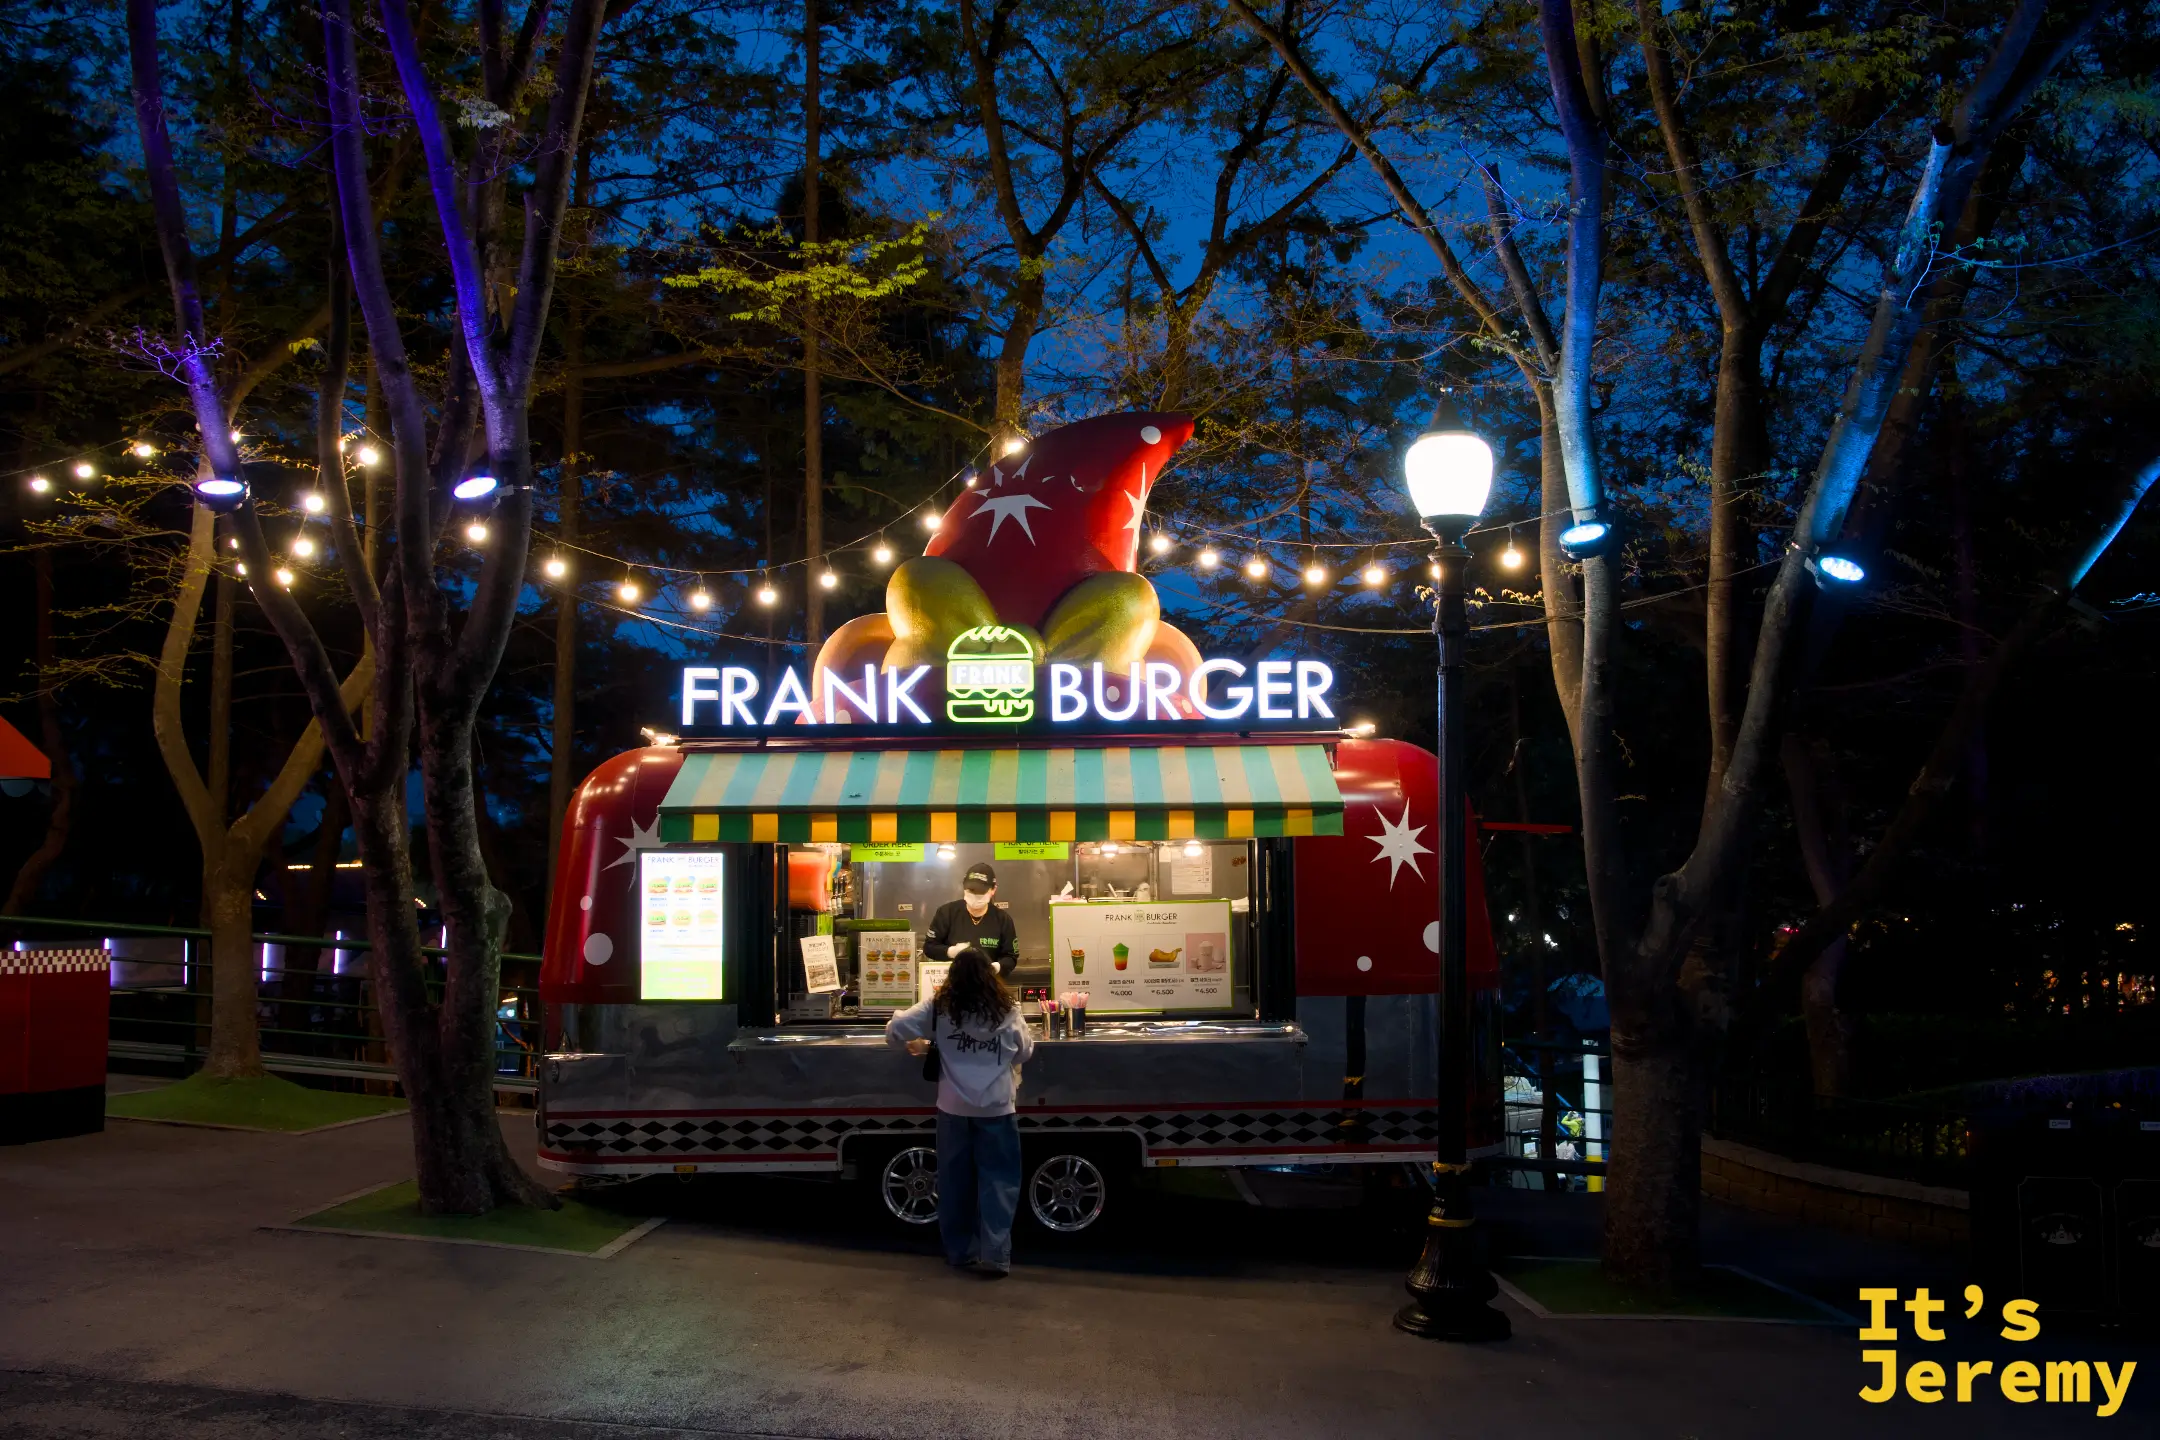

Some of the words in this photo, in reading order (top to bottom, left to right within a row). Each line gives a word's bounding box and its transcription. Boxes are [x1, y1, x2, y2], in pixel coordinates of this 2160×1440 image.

[956, 666, 1025, 684] FRANK
[682, 663, 931, 725] FRANK
[1050, 657, 1335, 721] BURGER
[647, 856, 675, 864] FRANK
[688, 856, 720, 864] BURGER
[1105, 913, 1132, 922] FRANK
[1146, 912, 1178, 921] BURGER
